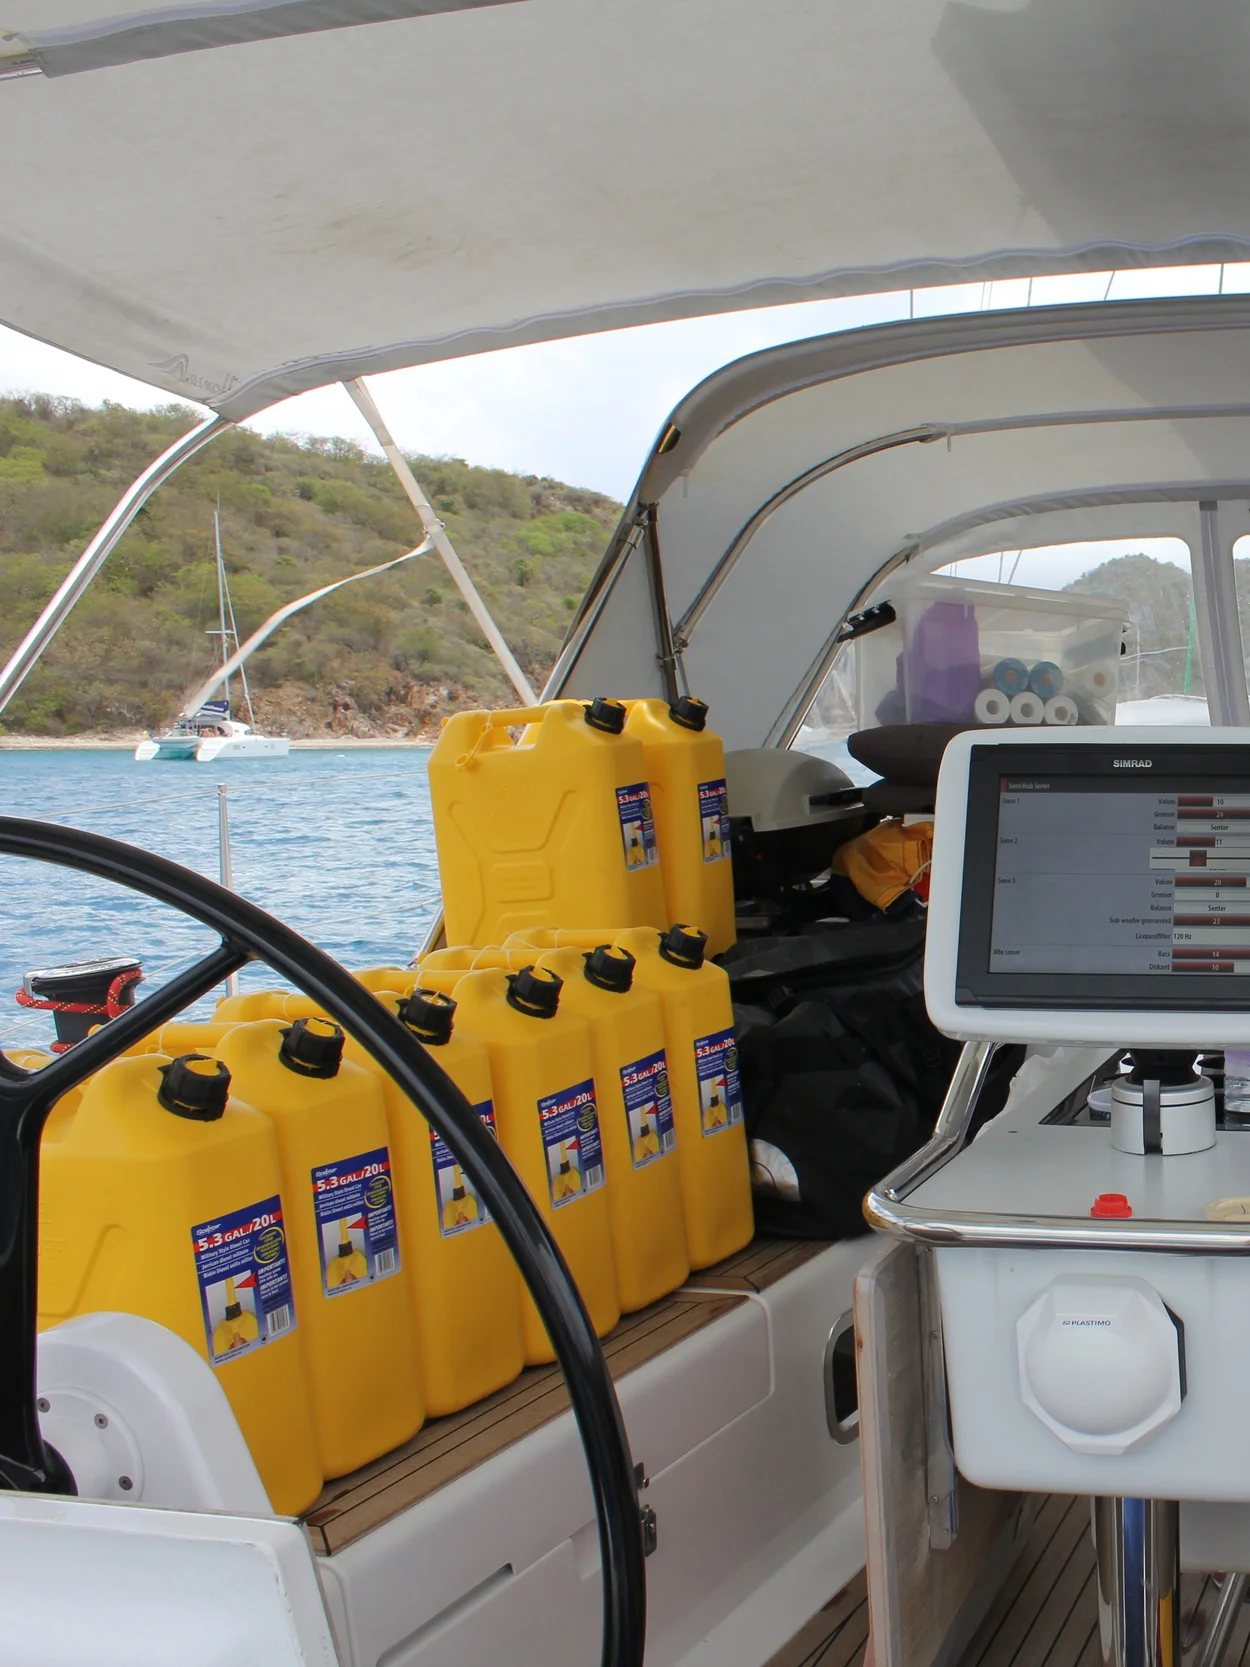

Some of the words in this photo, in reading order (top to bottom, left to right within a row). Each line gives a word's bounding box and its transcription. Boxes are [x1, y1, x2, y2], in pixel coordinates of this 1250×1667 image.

[1113, 760, 1152, 768] SIMRAD
[619, 795, 629, 804] 5.3
[700, 790, 709, 799] 5.3
[697, 1046, 710, 1058] 5.3
[623, 1073, 638, 1086] 5.3
[542, 1105, 558, 1120] 5.3
[316, 1176, 339, 1192] 5.3
[198, 1232, 223, 1252] 5.3
